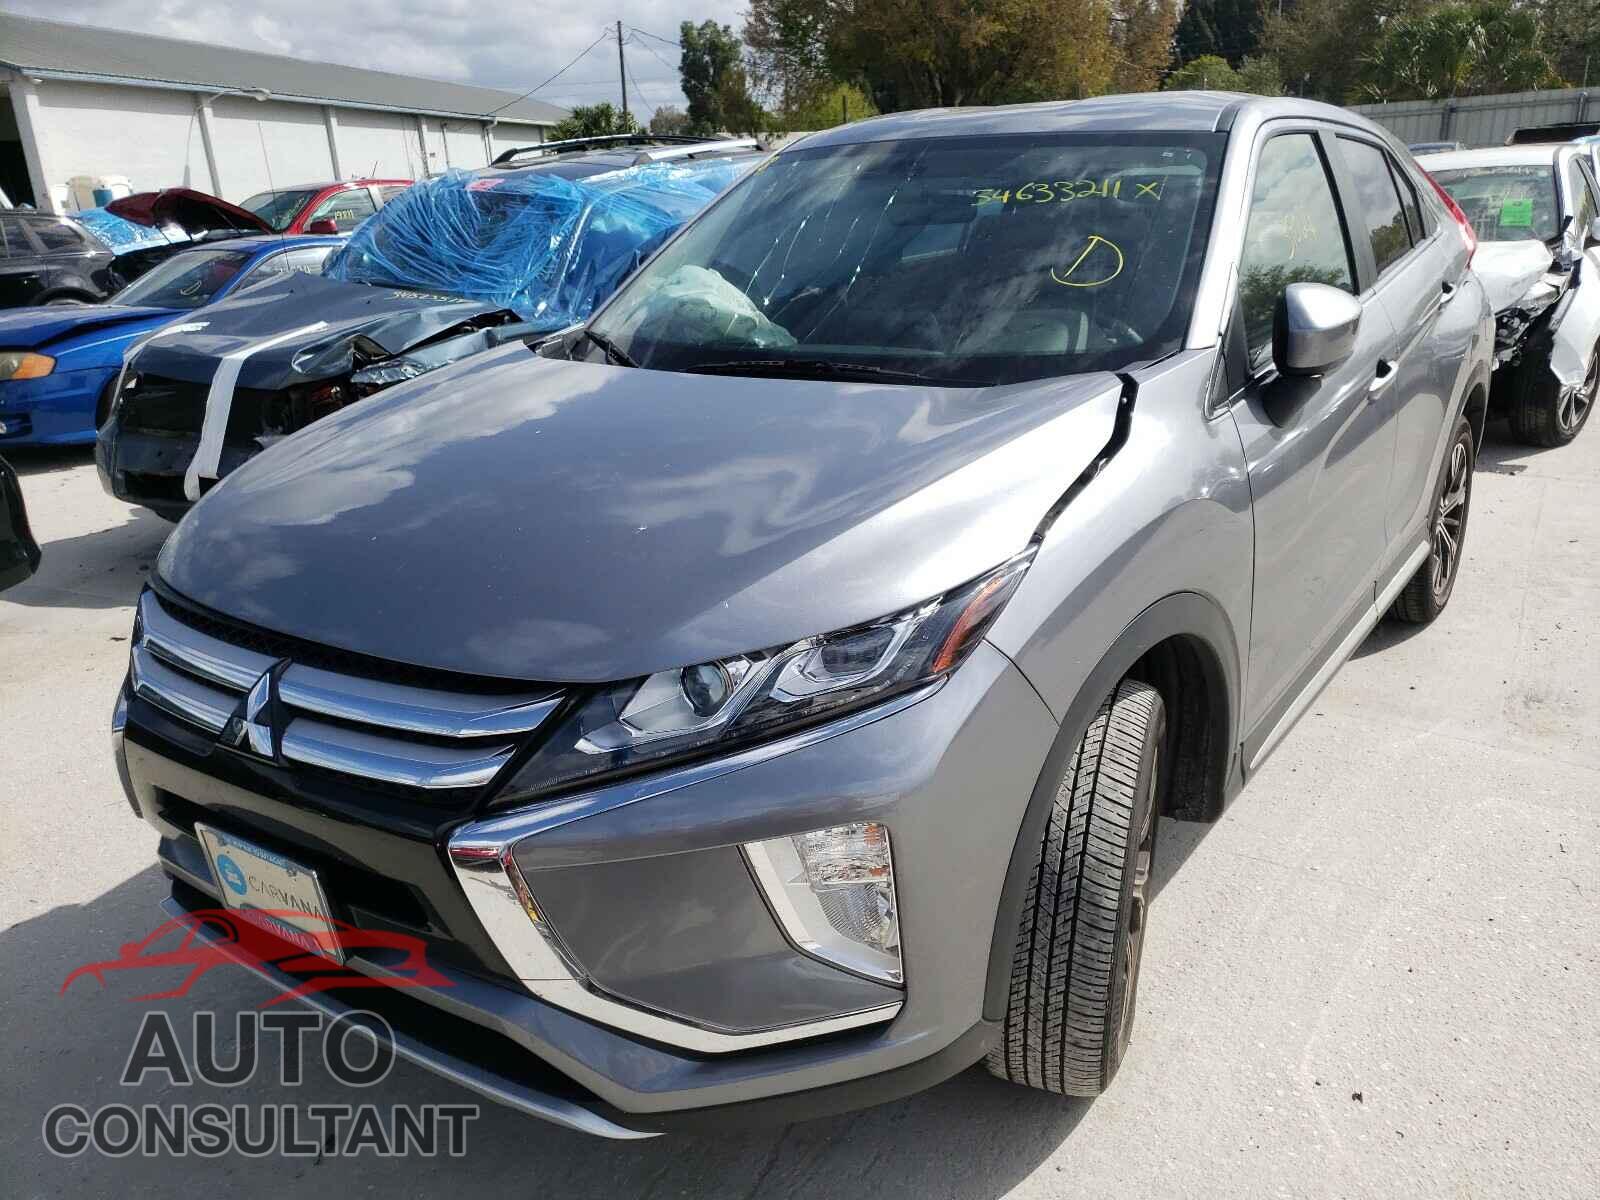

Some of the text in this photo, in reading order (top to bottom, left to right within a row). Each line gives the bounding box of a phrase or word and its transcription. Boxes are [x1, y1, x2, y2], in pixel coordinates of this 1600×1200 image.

[973, 180, 1120, 206] 34633211
[1050, 235, 1124, 287] D
[248, 875, 324, 921] CARVANA
